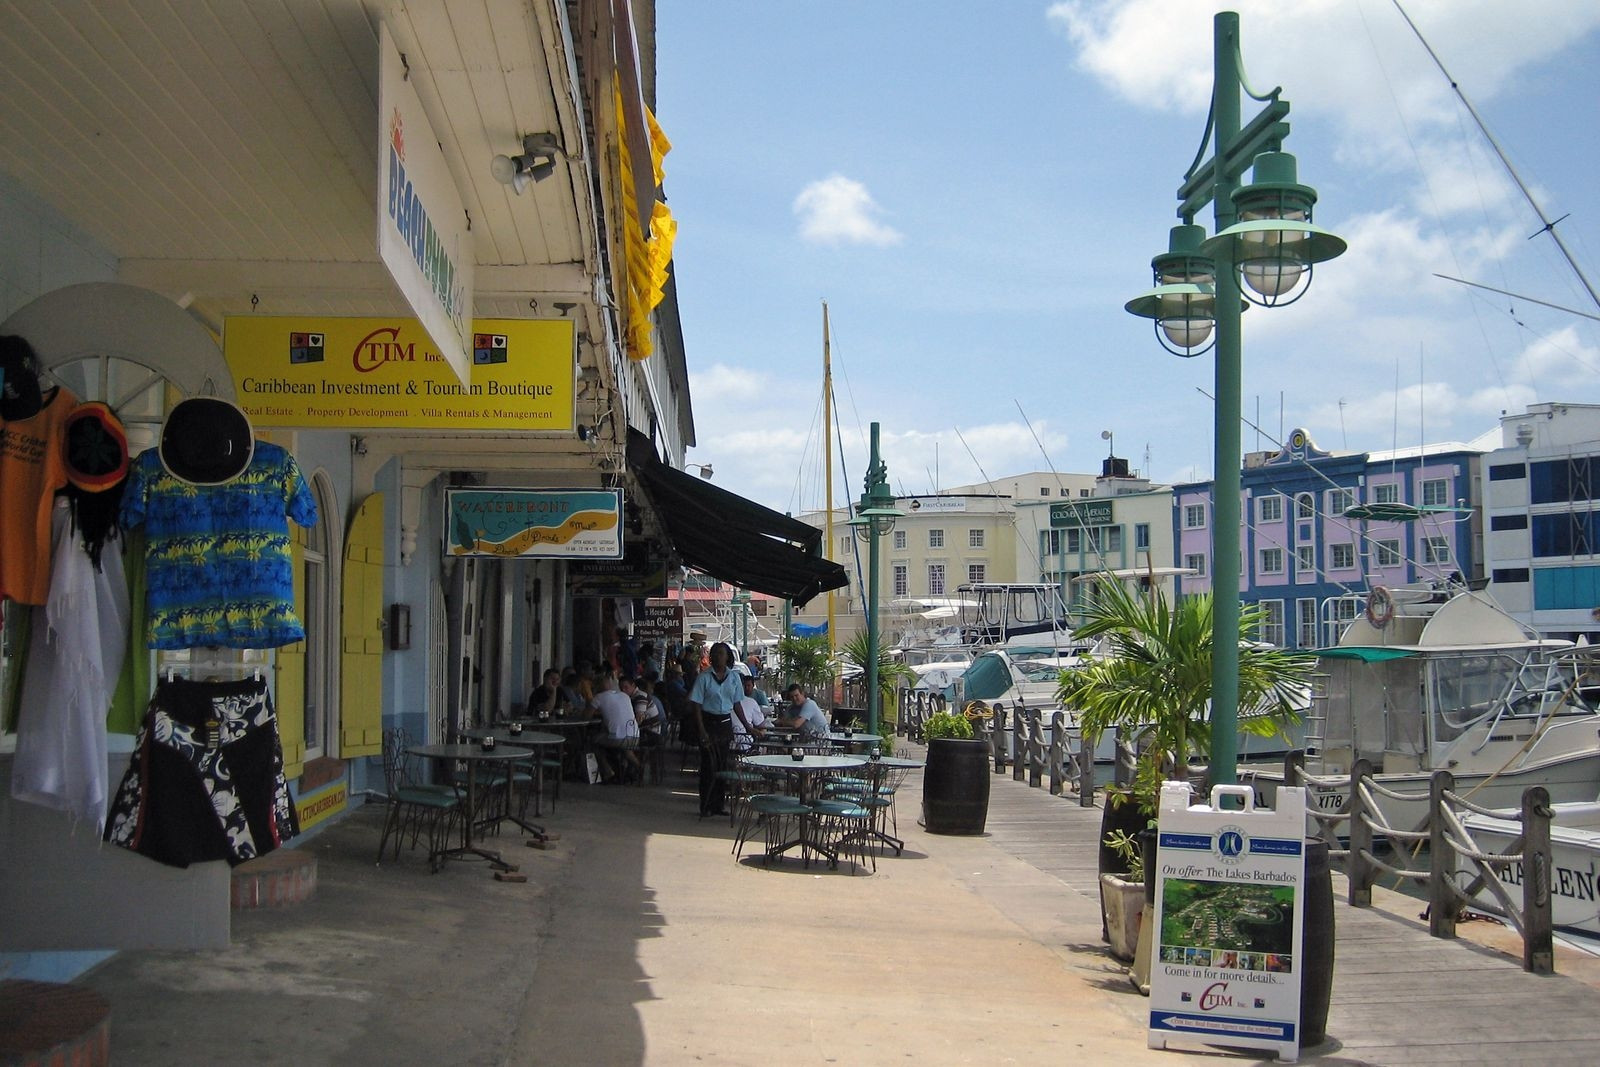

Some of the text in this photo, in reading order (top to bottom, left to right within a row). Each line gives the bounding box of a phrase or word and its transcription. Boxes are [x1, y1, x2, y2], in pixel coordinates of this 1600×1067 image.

[389, 143, 427, 273] BEACH
[352, 326, 445, 373] CTIM Inc.
[242, 377, 316, 394] Caribbean
[321, 379, 400, 395] Investment
[405, 380, 418, 395] &
[488, 380, 553, 399] Boutique
[242, 406, 552, 419] Real Estate Property Development Villa Rentals & Management
[458, 501, 571, 513] WATERFRONT
[649, 608, 667, 616] House
[667, 607, 675, 616] Of
[656, 617, 680, 629] Cigars
[1319, 795, 1342, 808] X178
[1162, 865, 1297, 882] On offer: The Lakes Barbados
[1164, 965, 1284, 984] Come in for more details...
[1199, 982, 1232, 1011] CTIM
